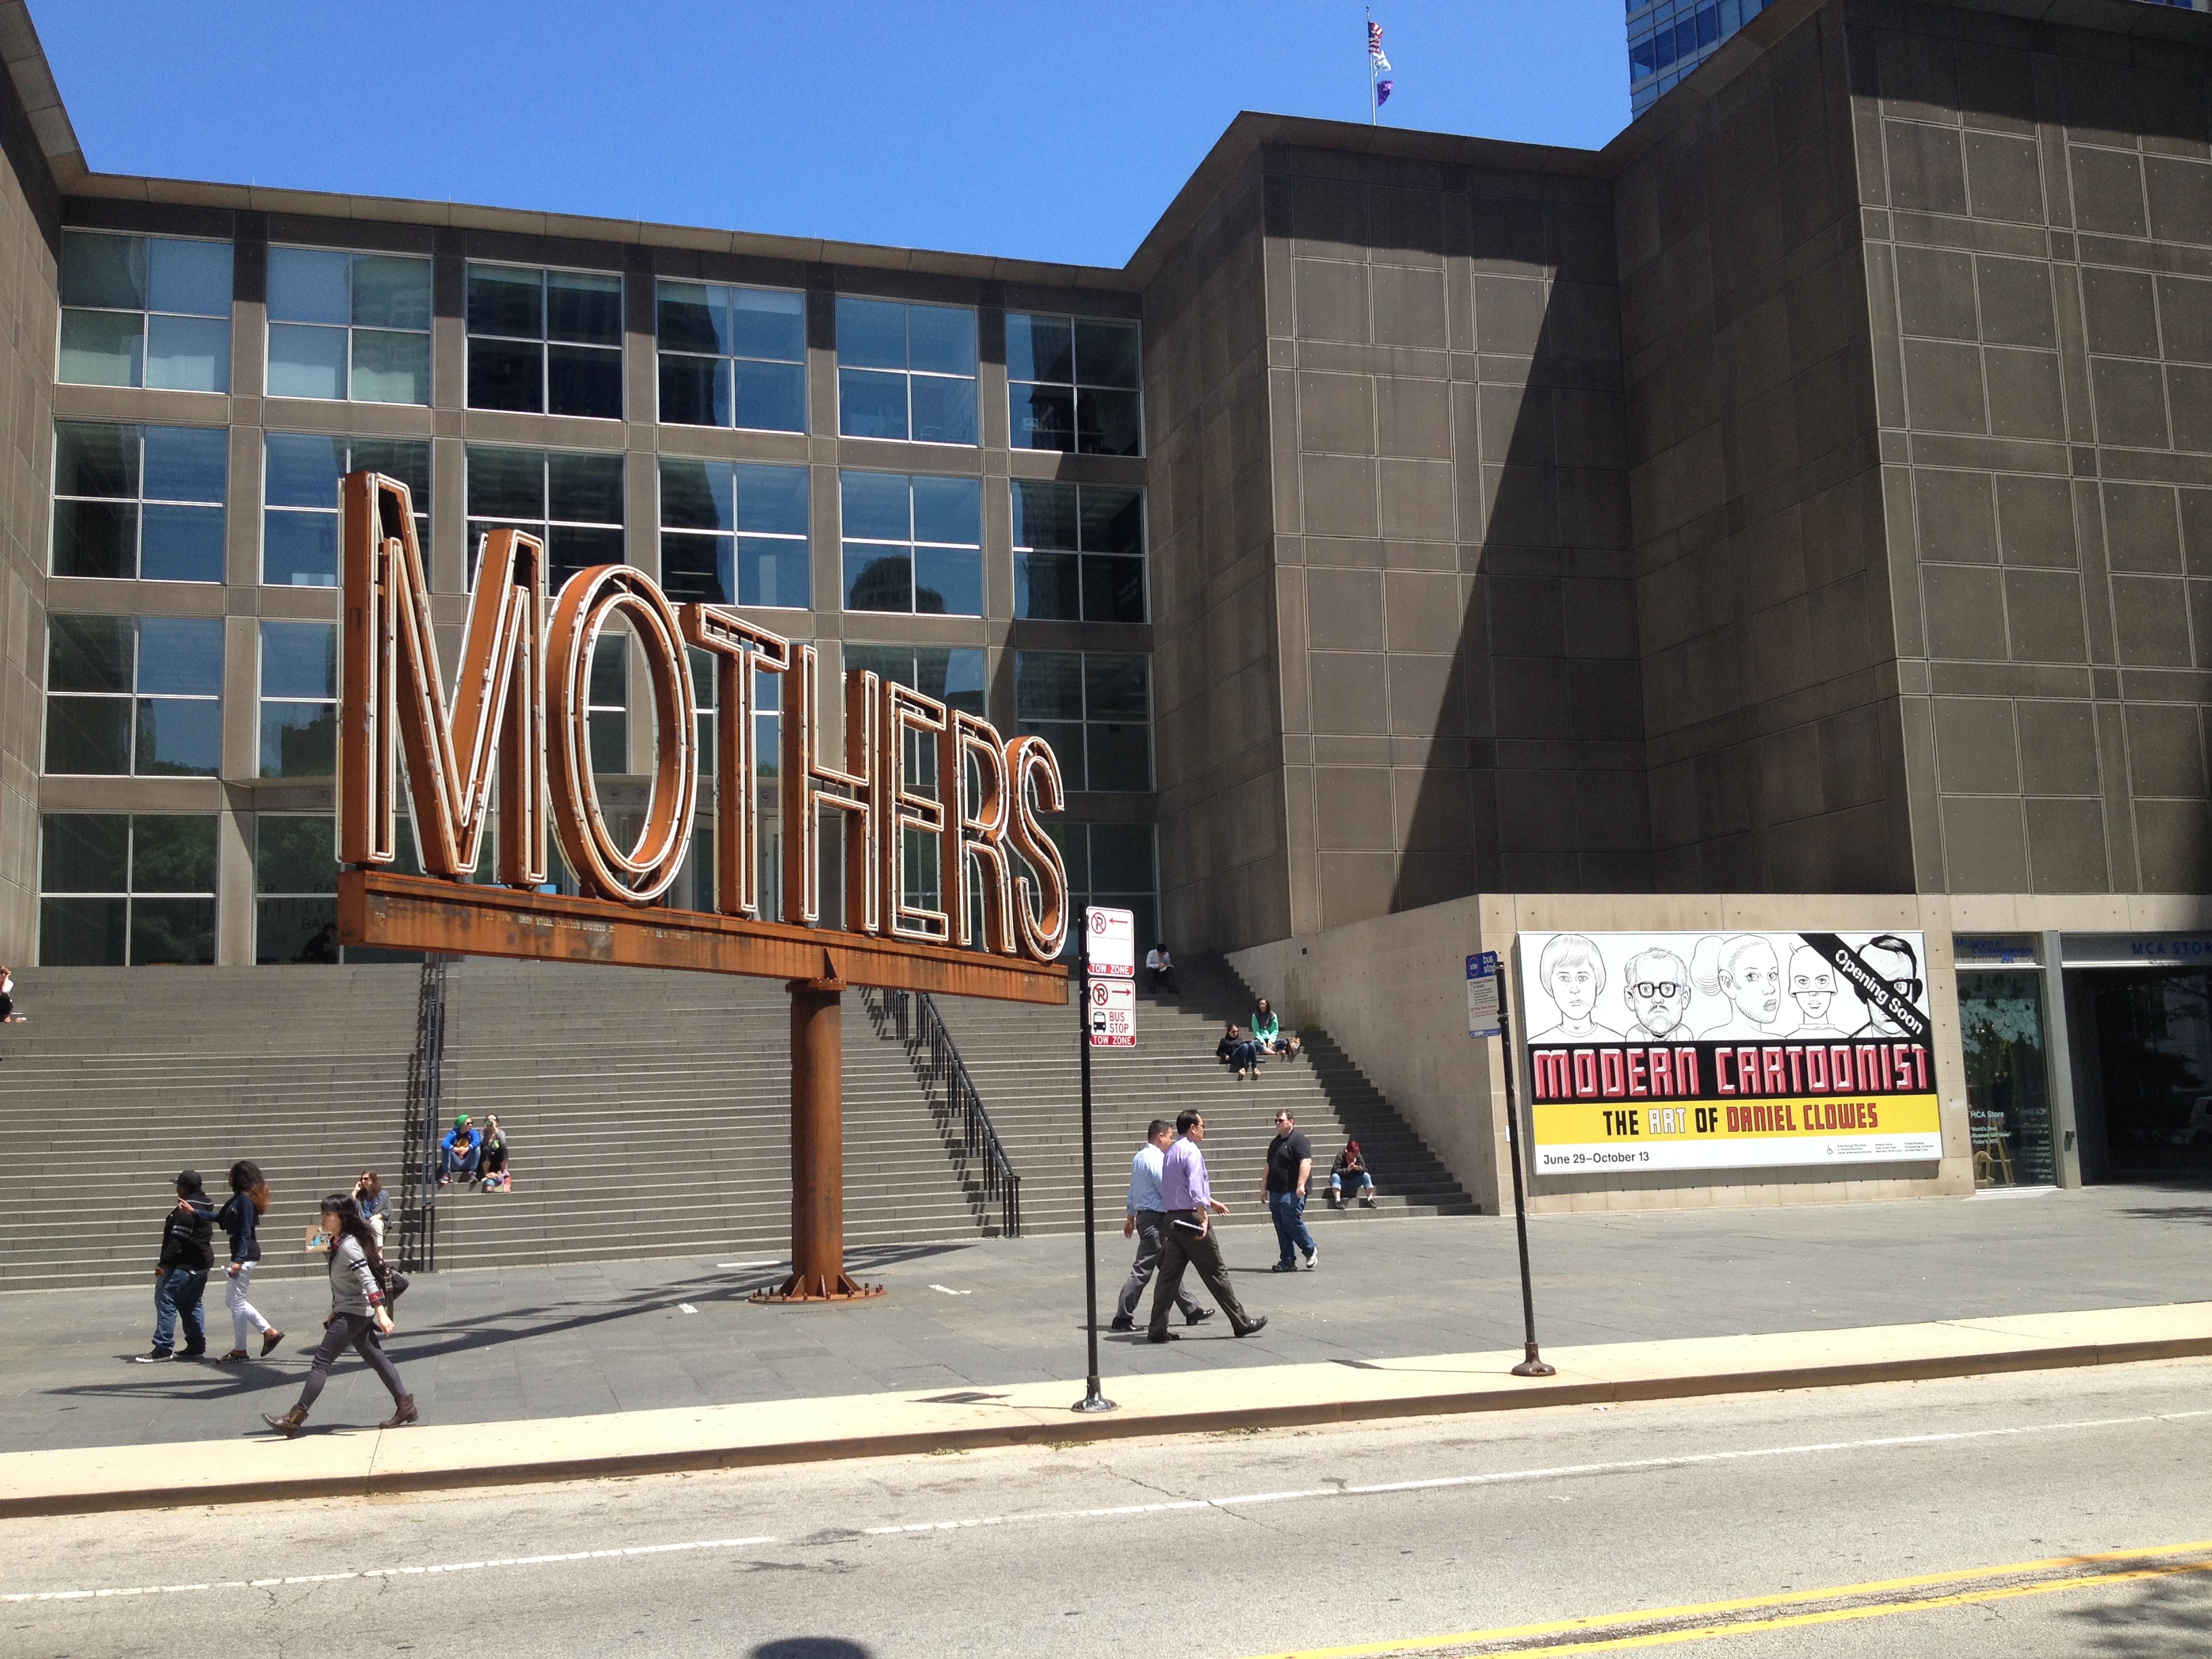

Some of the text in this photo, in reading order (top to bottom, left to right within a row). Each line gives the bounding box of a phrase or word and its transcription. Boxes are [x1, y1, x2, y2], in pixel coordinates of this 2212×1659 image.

[335, 471, 1068, 962] MOTHERS
[2131, 942, 2166, 955] MCA
[1483, 955, 1493, 964] bus
[1090, 964, 1130, 975] TOW ZONE
[1835, 949, 1923, 1035] Opening Soon
[1109, 1012, 1125, 1022] BUS
[1109, 1023, 1129, 1033] STOP
[1093, 1036, 1132, 1045] TOW ZONE
[1533, 1044, 1927, 1099] MODERN CARTOONIST
[1603, 1103, 1878, 1136] THE ART OF DANIEL CLOWES
[1544, 1155, 1570, 1164] June
[1638, 1151, 1650, 1162] 13
